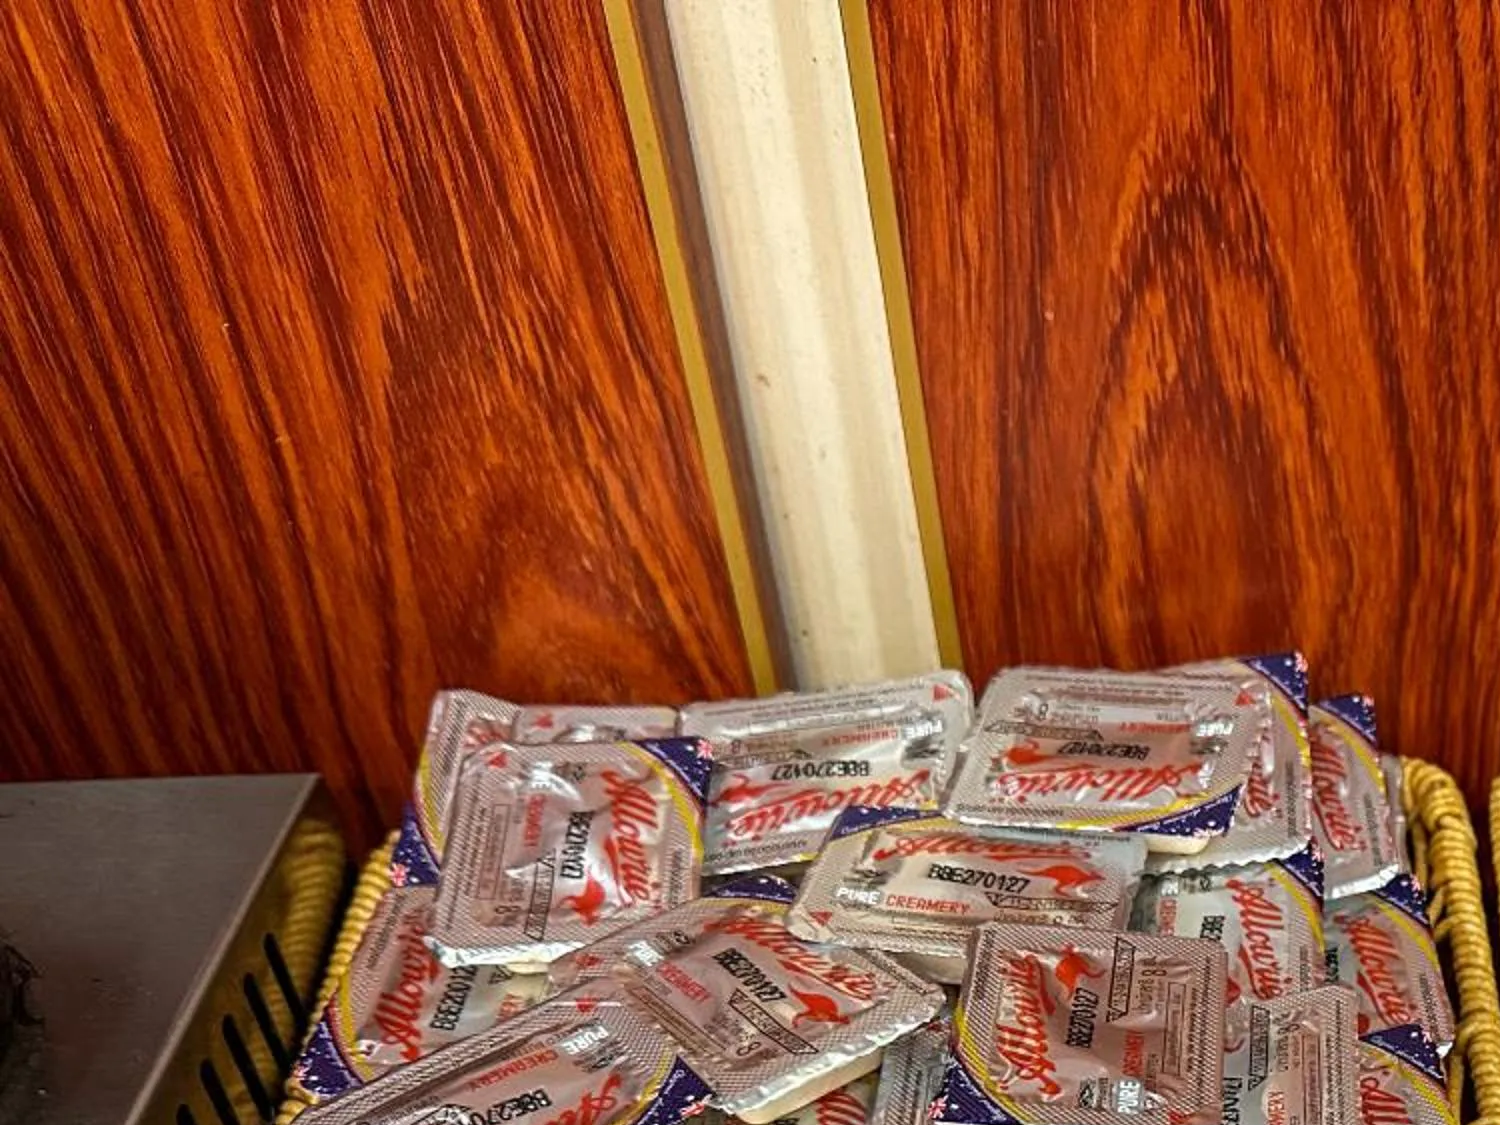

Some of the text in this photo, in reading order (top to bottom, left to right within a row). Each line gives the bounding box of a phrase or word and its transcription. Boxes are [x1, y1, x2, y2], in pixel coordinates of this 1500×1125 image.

[906, 719, 942, 737] PURE
[1197, 720, 1233, 738] PURE
[925, 861, 1032, 894] BBE270127
[834, 886, 971, 916] PURE CREAMERY
[469, 1025, 608, 1094] PURE CREAMERY
[1117, 1080, 1141, 1116] PURE
